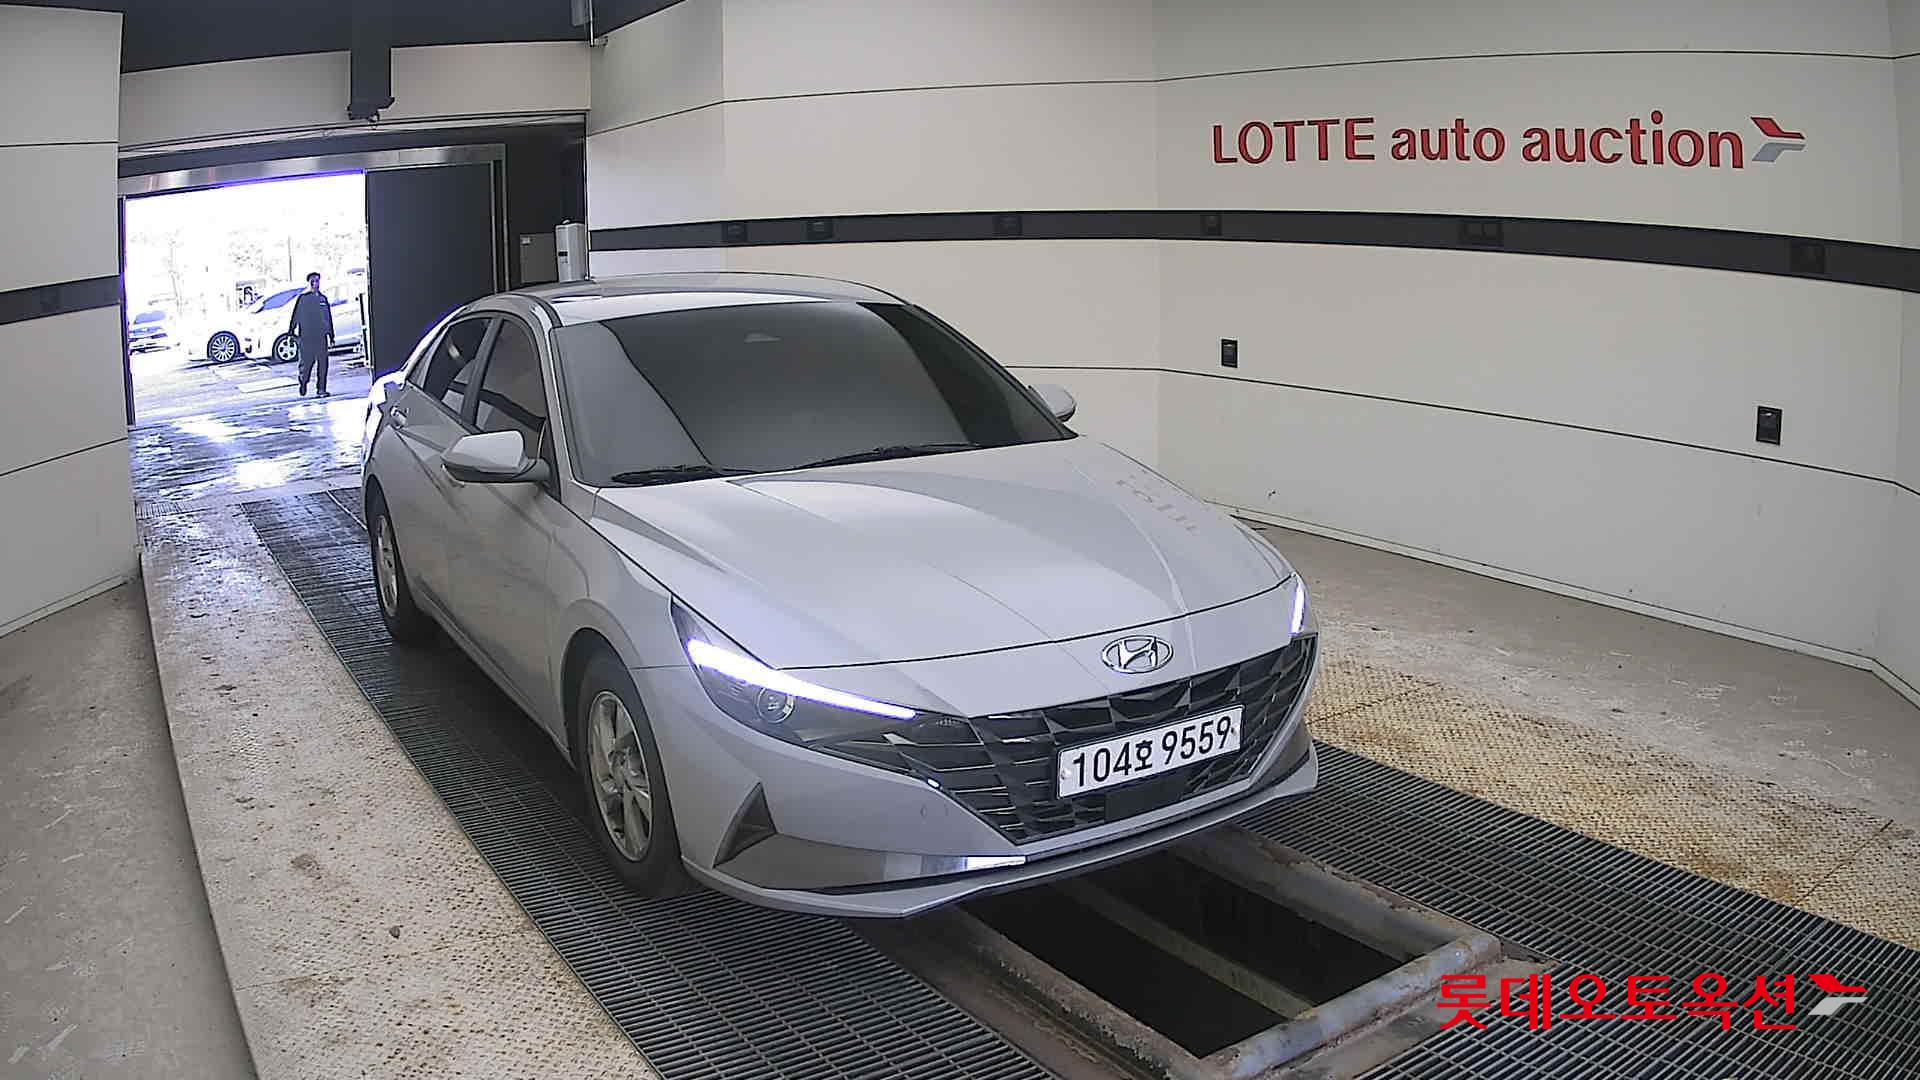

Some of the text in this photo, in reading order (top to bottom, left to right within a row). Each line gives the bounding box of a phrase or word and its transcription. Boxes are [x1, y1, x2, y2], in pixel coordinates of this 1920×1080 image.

[1213, 110, 1744, 168] LOTTE auto auction
[1073, 716, 1232, 787] 104호 9559
